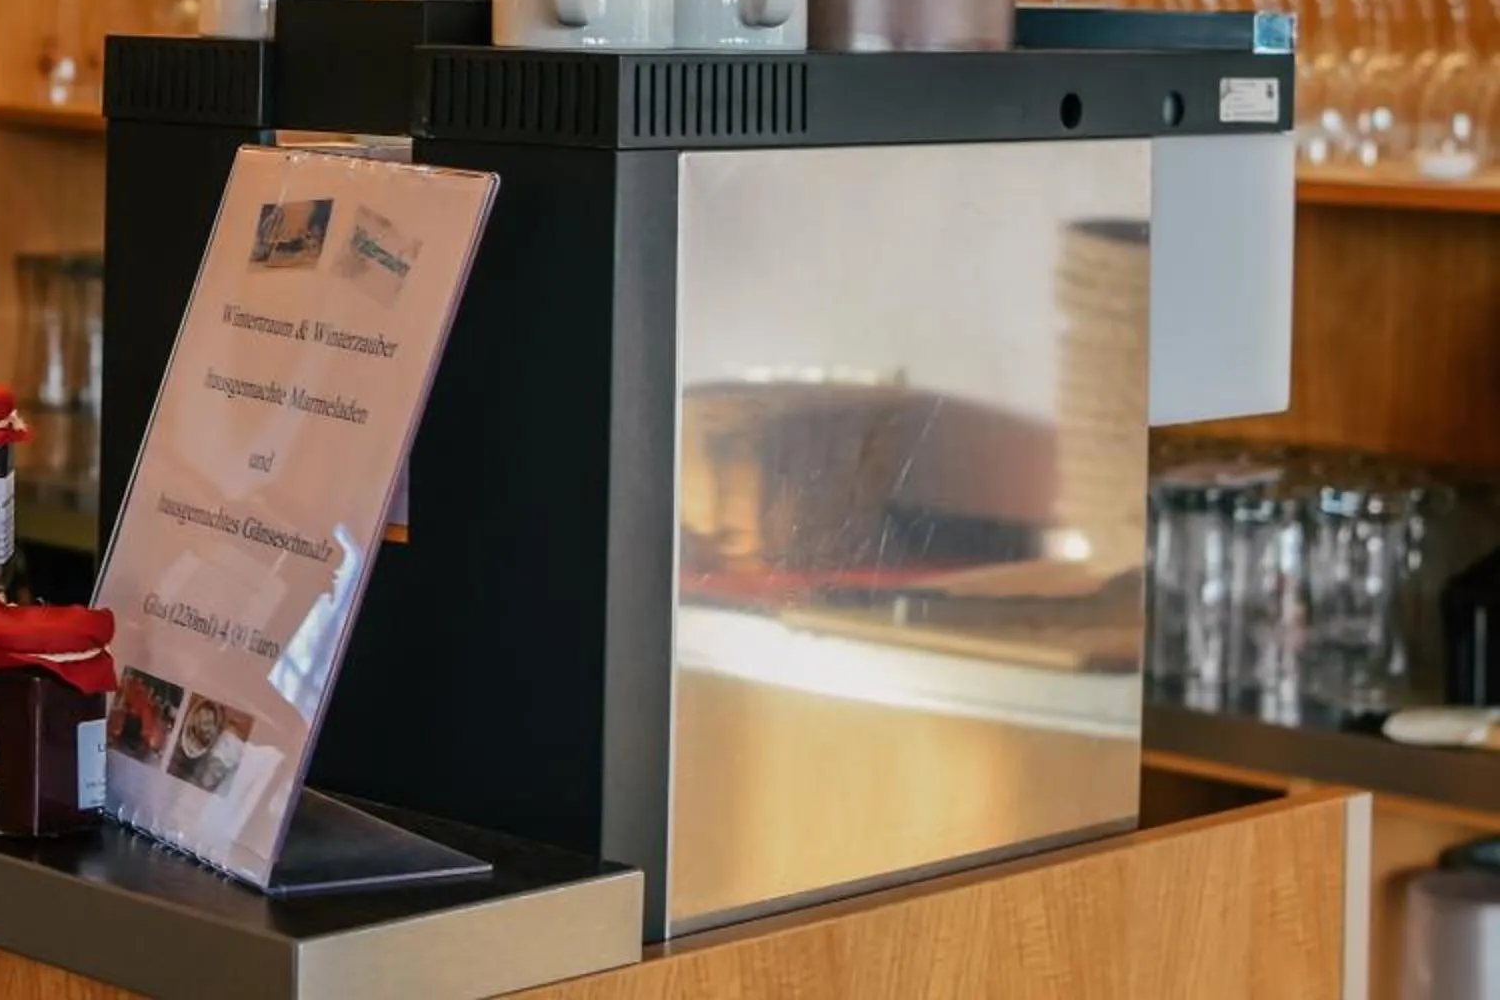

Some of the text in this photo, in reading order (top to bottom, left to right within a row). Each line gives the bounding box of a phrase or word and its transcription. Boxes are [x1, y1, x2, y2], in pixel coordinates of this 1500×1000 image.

[295, 319, 309, 341] &
[314, 321, 398, 359] Winterzauber
[287, 386, 368, 424] Marmeladen
[247, 450, 276, 473] und
